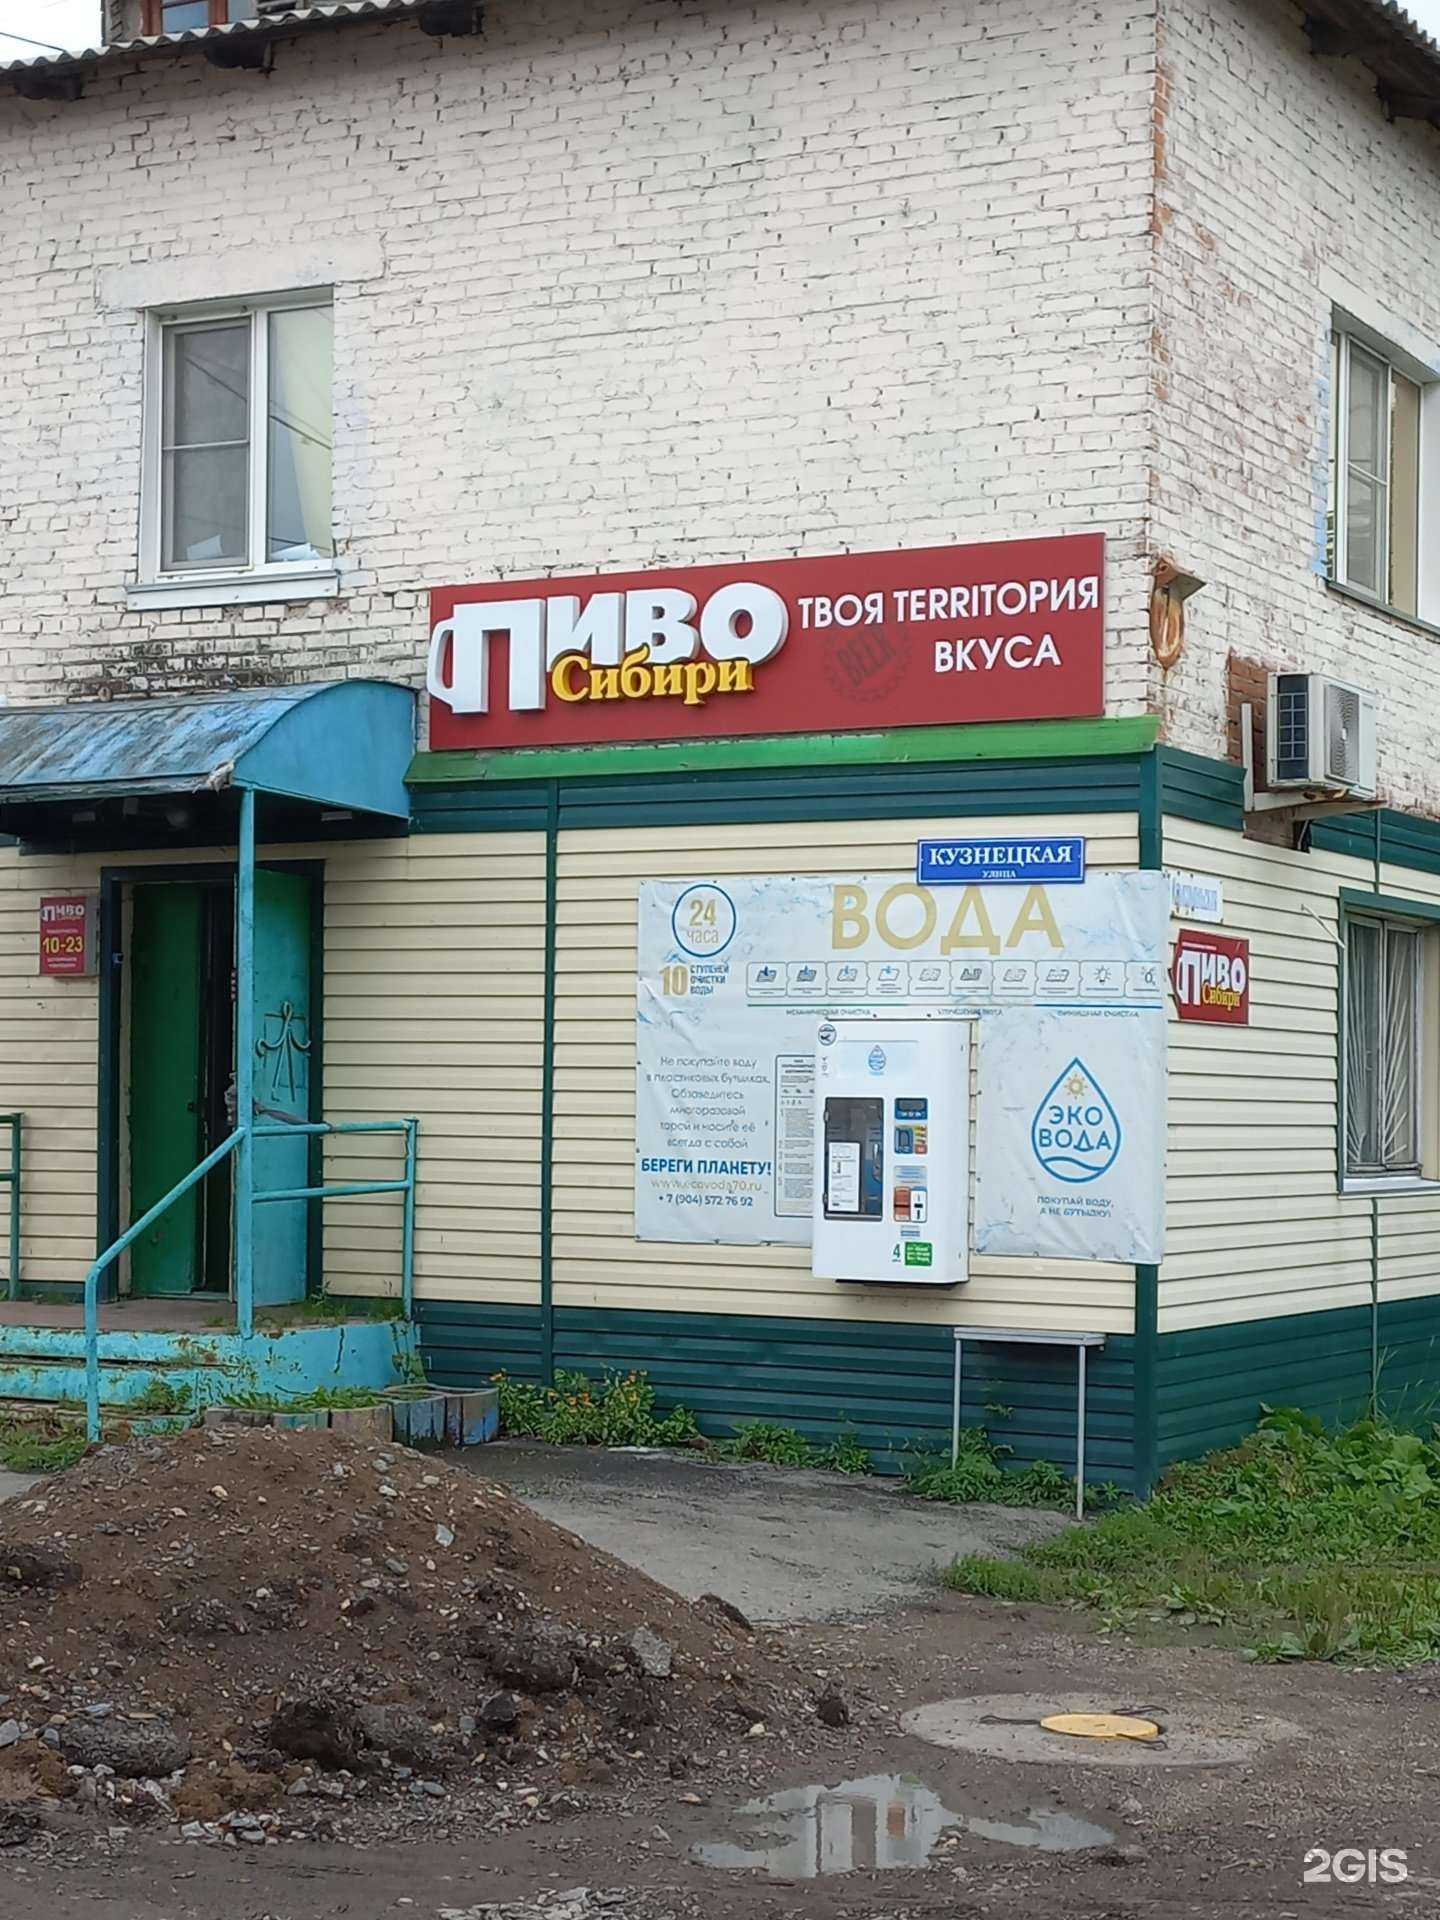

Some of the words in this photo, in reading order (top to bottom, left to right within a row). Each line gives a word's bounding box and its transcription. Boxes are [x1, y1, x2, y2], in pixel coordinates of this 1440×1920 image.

[798, 592, 884, 629] ТВОЯ
[427, 582, 789, 713] ПИВО
[934, 633, 1062, 673] ВКУСА
[552, 643, 754, 705] Сибири
[928, 844, 1074, 867] КУЗНЕЦКАЯ
[981, 869, 1017, 880] УЛИЦА
[41, 904, 85, 922] ПИВО
[689, 899, 717, 927] 24
[832, 882, 1065, 956] ВОДА
[42, 936, 84, 954] 10-23
[686, 929, 719, 944] часа
[659, 965, 689, 996] 10
[690, 975, 726, 985] ОЧИСТКИ
[1176, 949, 1247, 1006] ПИВО
[690, 985, 714, 996] ВОДЫ
[1202, 981, 1241, 1011] Сибири
[660, 1056, 674, 1067] Не
[670, 1104, 747, 1117] многоразовой
[1048, 1105, 1104, 1126] ЭКО
[666, 1138, 702, 1148] всегда
[704, 1138, 712, 1148] с
[715, 1136, 749, 1149] собой
[1038, 1127, 1112, 1152] ВОДА
[641, 1158, 693, 1173] БЕРЕГИ
[697, 1160, 772, 1176] ПЛАНЕТУ!
[675, 1193, 702, 1206] (904)
[705, 1195, 723, 1206] 572
[725, 1196, 738, 1207] 76
[1037, 1195, 1083, 1206] ПОКУПАЙ
[1040, 1206, 1047, 1215] А
[1049, 1206, 1061, 1216] НЕ
